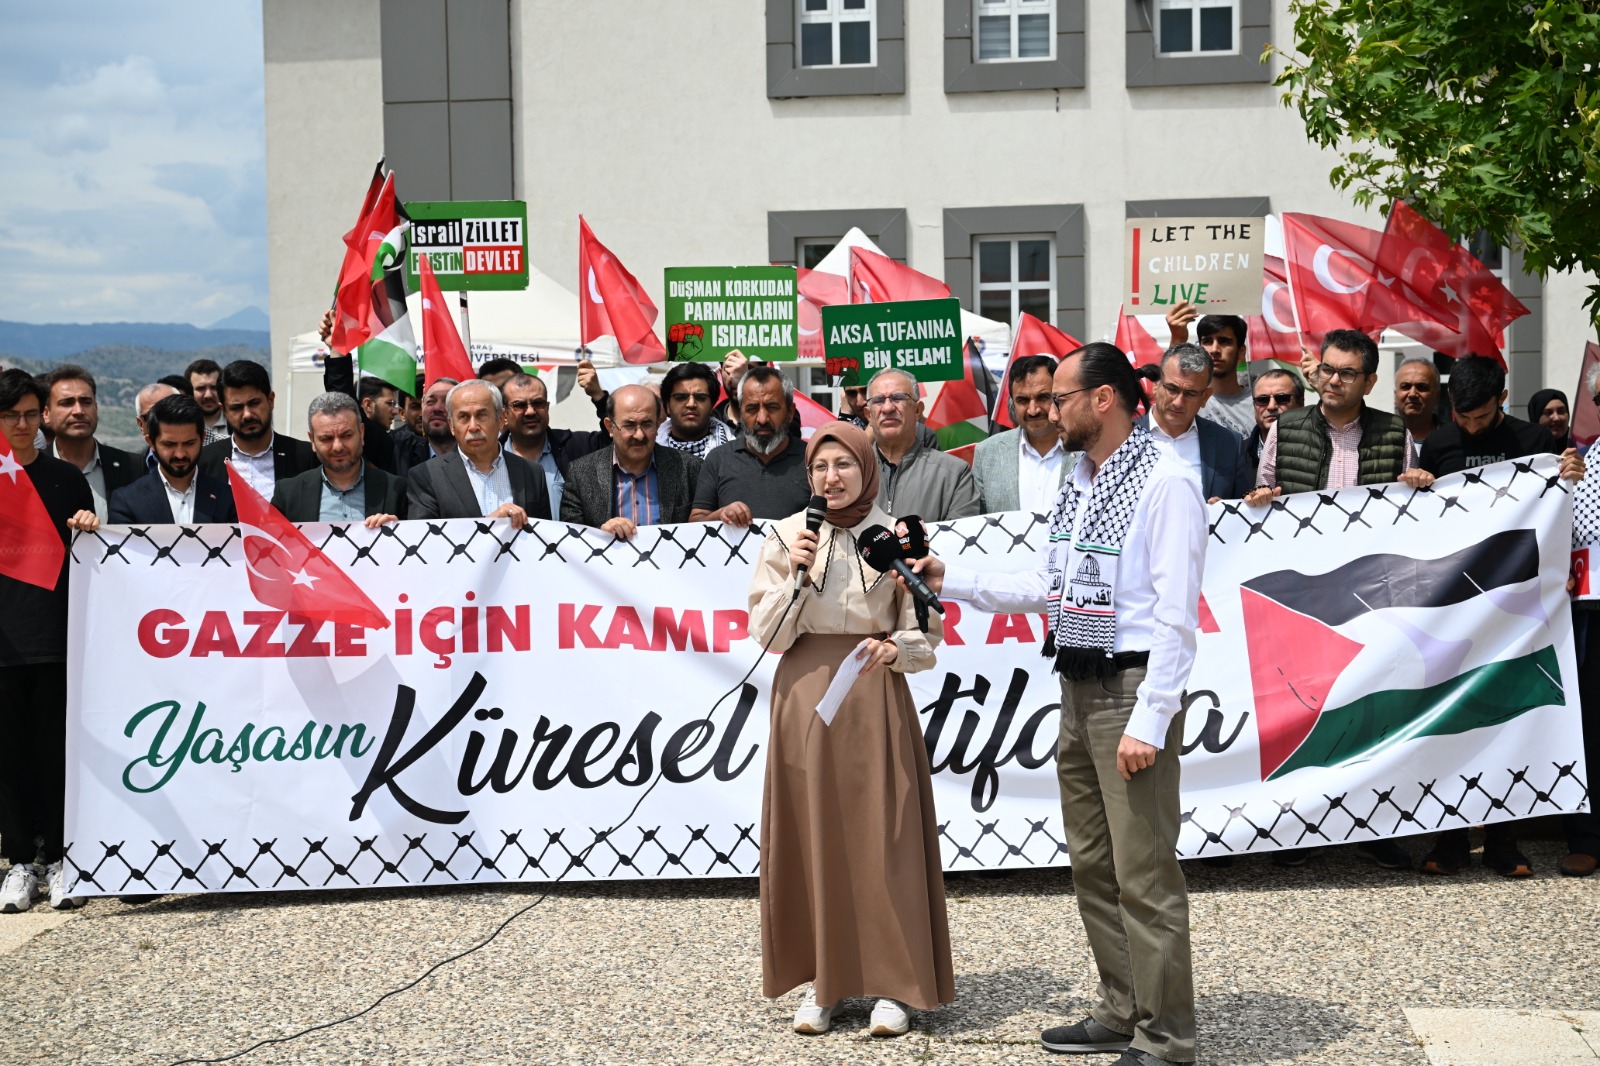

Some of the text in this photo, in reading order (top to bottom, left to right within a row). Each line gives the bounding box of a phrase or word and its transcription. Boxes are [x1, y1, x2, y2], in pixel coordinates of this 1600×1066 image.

[411, 222, 461, 244] israil
[1150, 224, 1251, 242] LET THE
[412, 250, 520, 271] FiSTiN DEVLET
[1149, 253, 1249, 274] CHILDREN
[725, 280, 793, 297] KORKUDAN
[684, 301, 793, 321] PARMAKLARINI
[712, 324, 793, 347] ISIRACAK
[830, 319, 956, 344] AKSA TUFANINA
[896, 346, 951, 367] SELAM!
[137, 609, 368, 658] GAZZE
[395, 591, 531, 669] İÇİN
[122, 700, 376, 793] Yaşasın
[348, 671, 760, 825] Küresel
